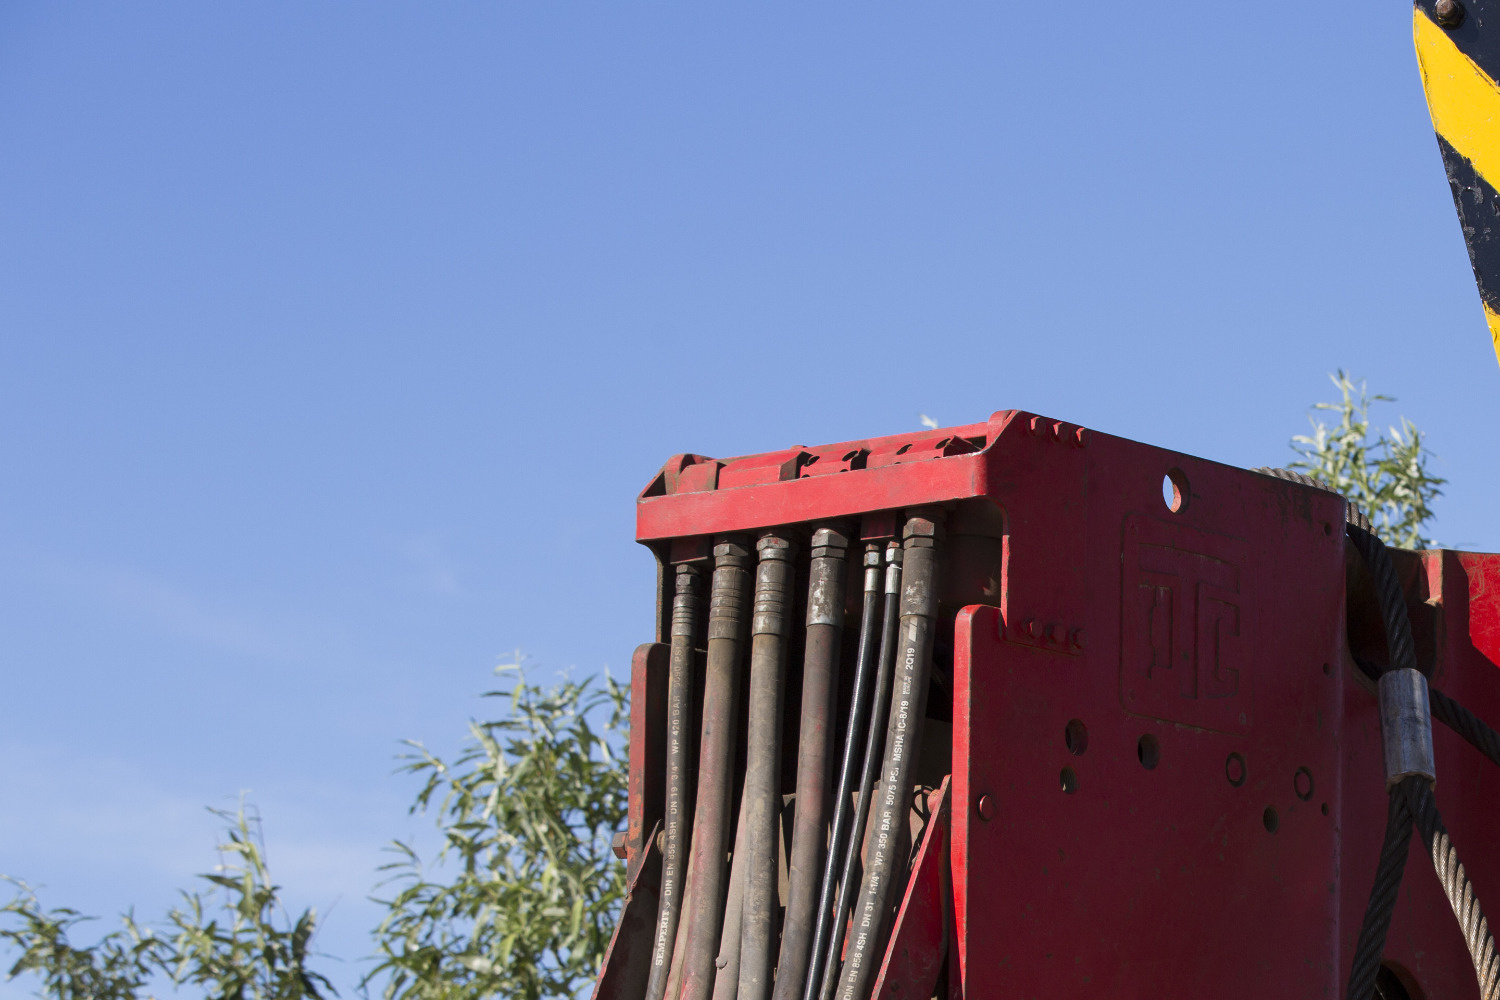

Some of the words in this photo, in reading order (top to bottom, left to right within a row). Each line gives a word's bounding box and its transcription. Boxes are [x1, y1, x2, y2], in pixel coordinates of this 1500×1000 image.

[905, 647, 915, 670] 2Q19
[897, 700, 909, 732] IC-8/19
[672, 719, 680, 736] 420
[672, 741, 680, 755] WP
[892, 734, 905, 762] MSHA
[670, 786, 678, 797] 19
[886, 784, 897, 806] 5075
[670, 801, 677, 815] DN
[881, 811, 892, 831] BAR
[669, 822, 677, 840] 4SH
[878, 833, 888, 849] 350
[668, 843, 676, 859] 856
[874, 851, 884, 867] WP
[666, 864, 674, 876] EN
[664, 880, 673, 896] DIN
[865, 901, 875, 912] 31
[862, 912, 872, 927] DN
[656, 910, 670, 966] SEMPERIT
[856, 932, 868, 951] 4SH
[852, 952, 863, 969] 856
[848, 970, 858, 983] EN
[843, 985, 855, 1000] DIN
